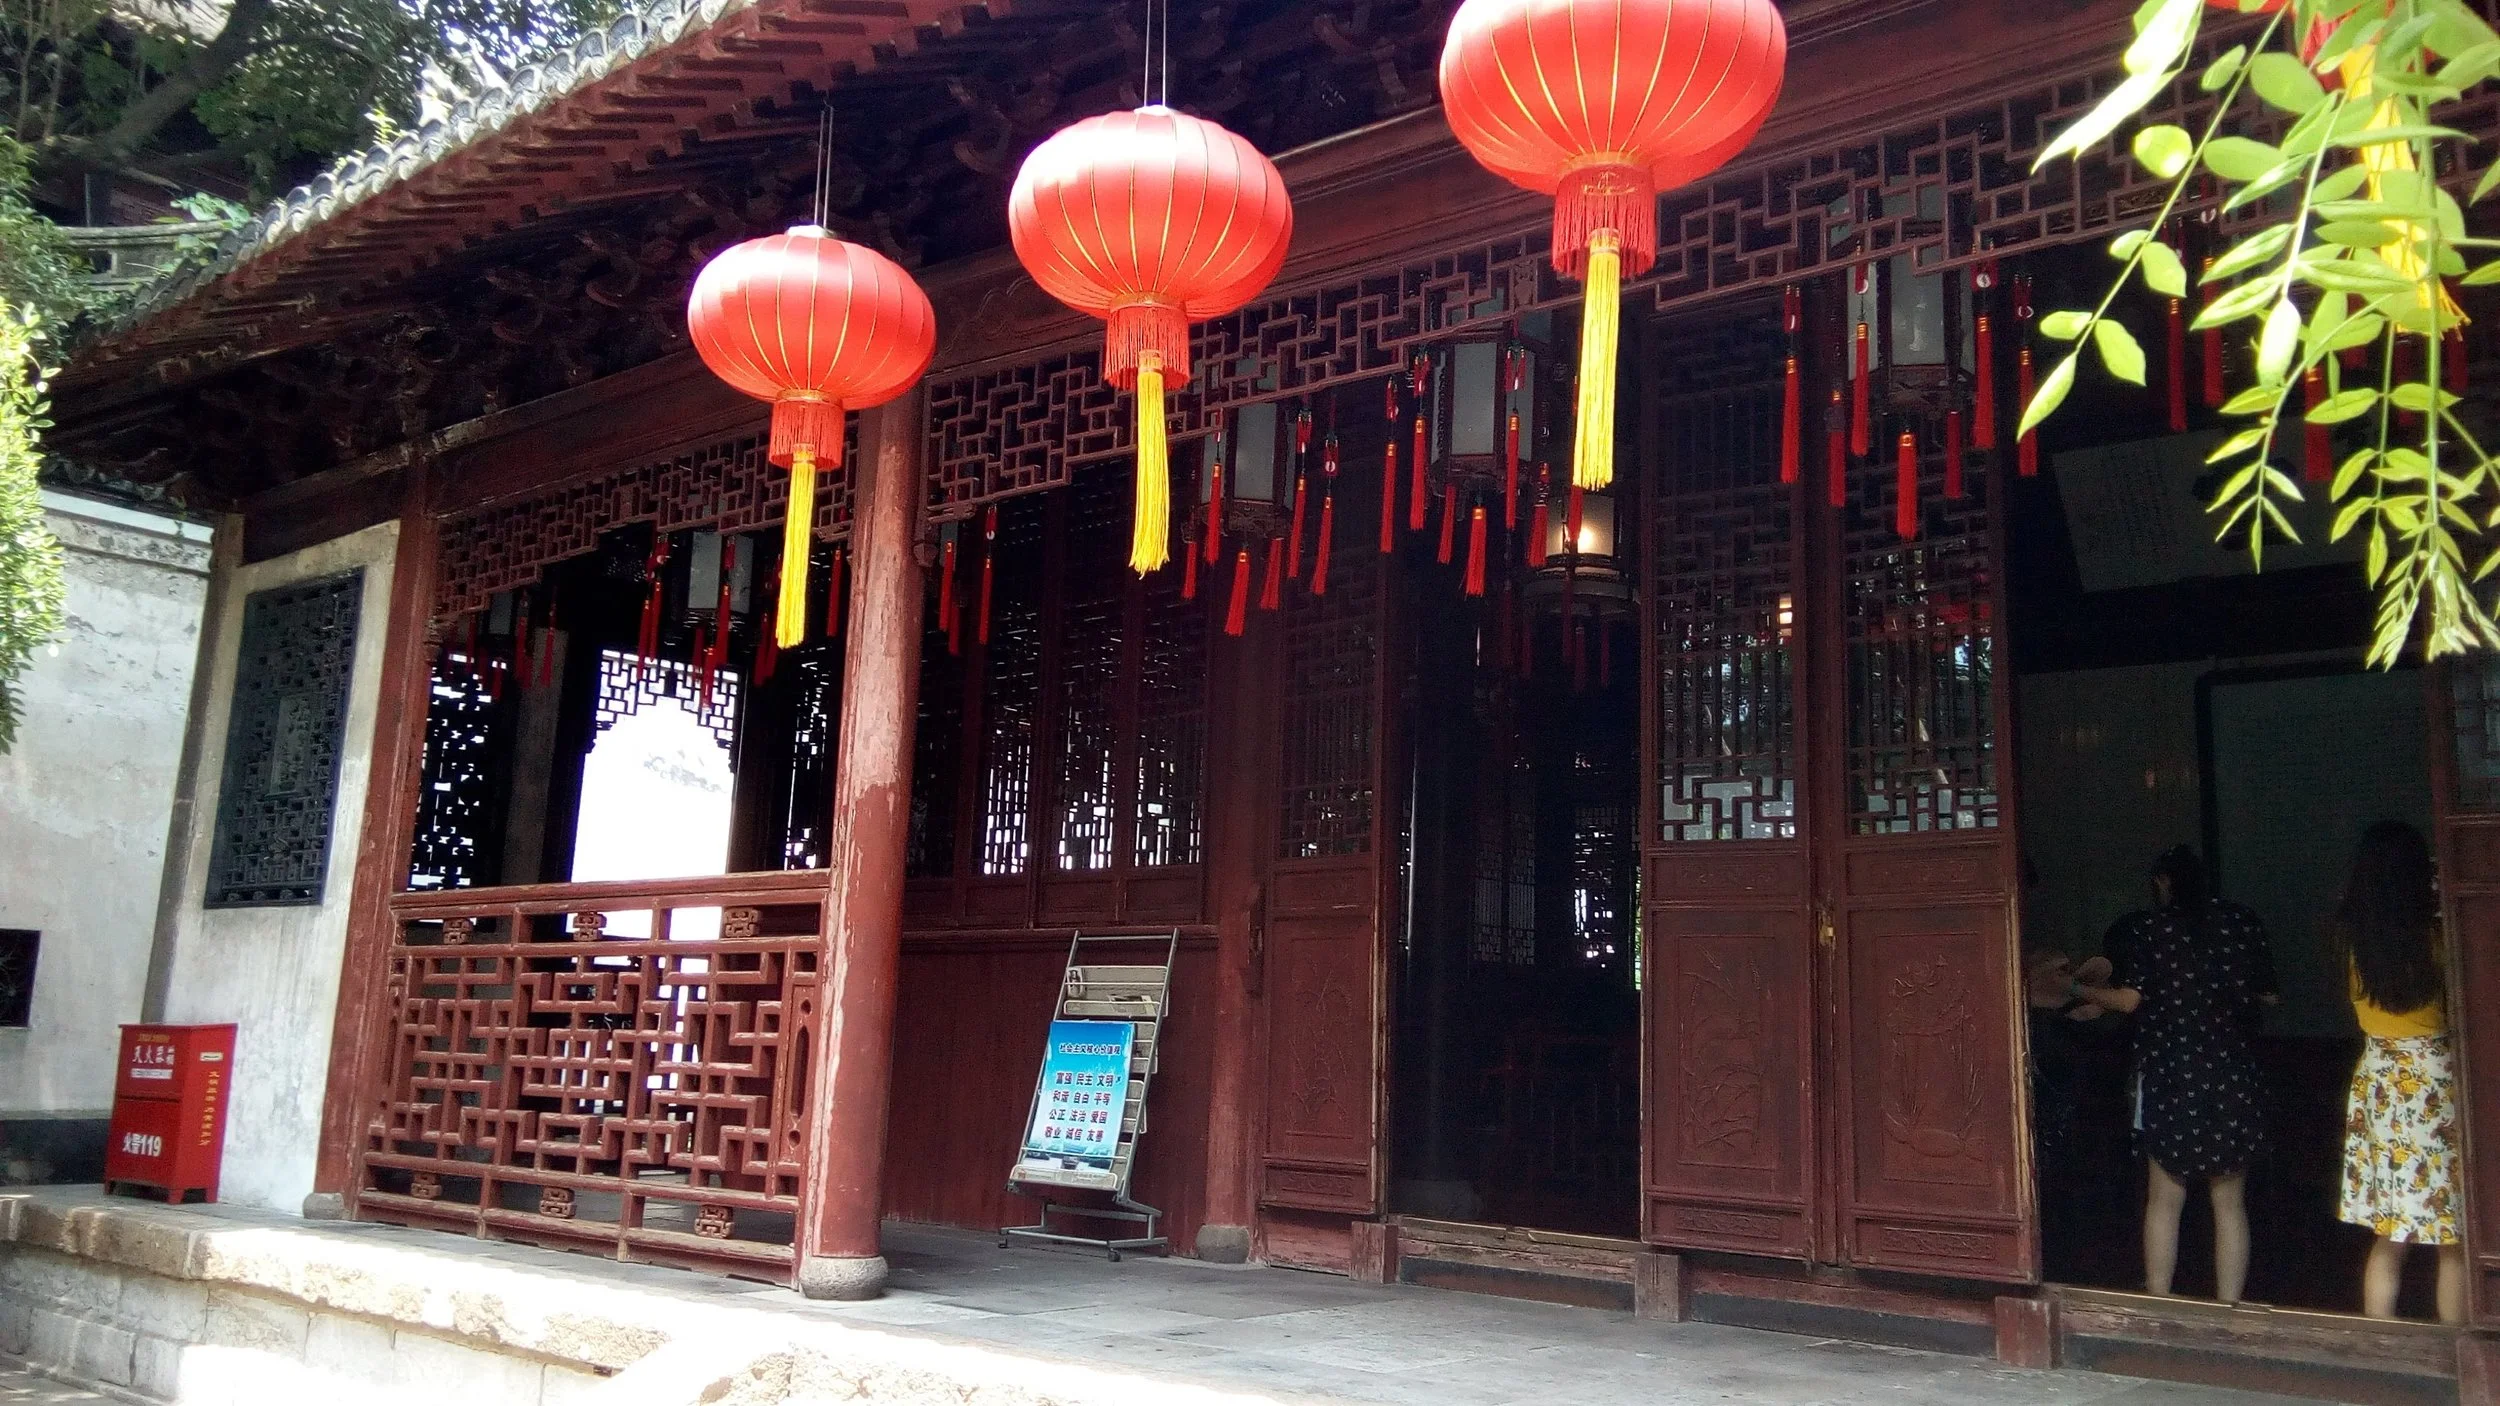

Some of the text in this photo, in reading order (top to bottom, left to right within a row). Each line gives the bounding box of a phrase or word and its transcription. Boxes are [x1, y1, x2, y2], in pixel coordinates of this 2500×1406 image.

[1059, 1043, 1121, 1055] 社会主义核心价值观
[1056, 1072, 1114, 1087] 富强 民主 文明
[1053, 1090, 1111, 1105] 和谐 自由 平等
[1049, 1109, 1108, 1124] 公正 法治 爱国
[1044, 1126, 1104, 1143] 敬业 诚信 友善
